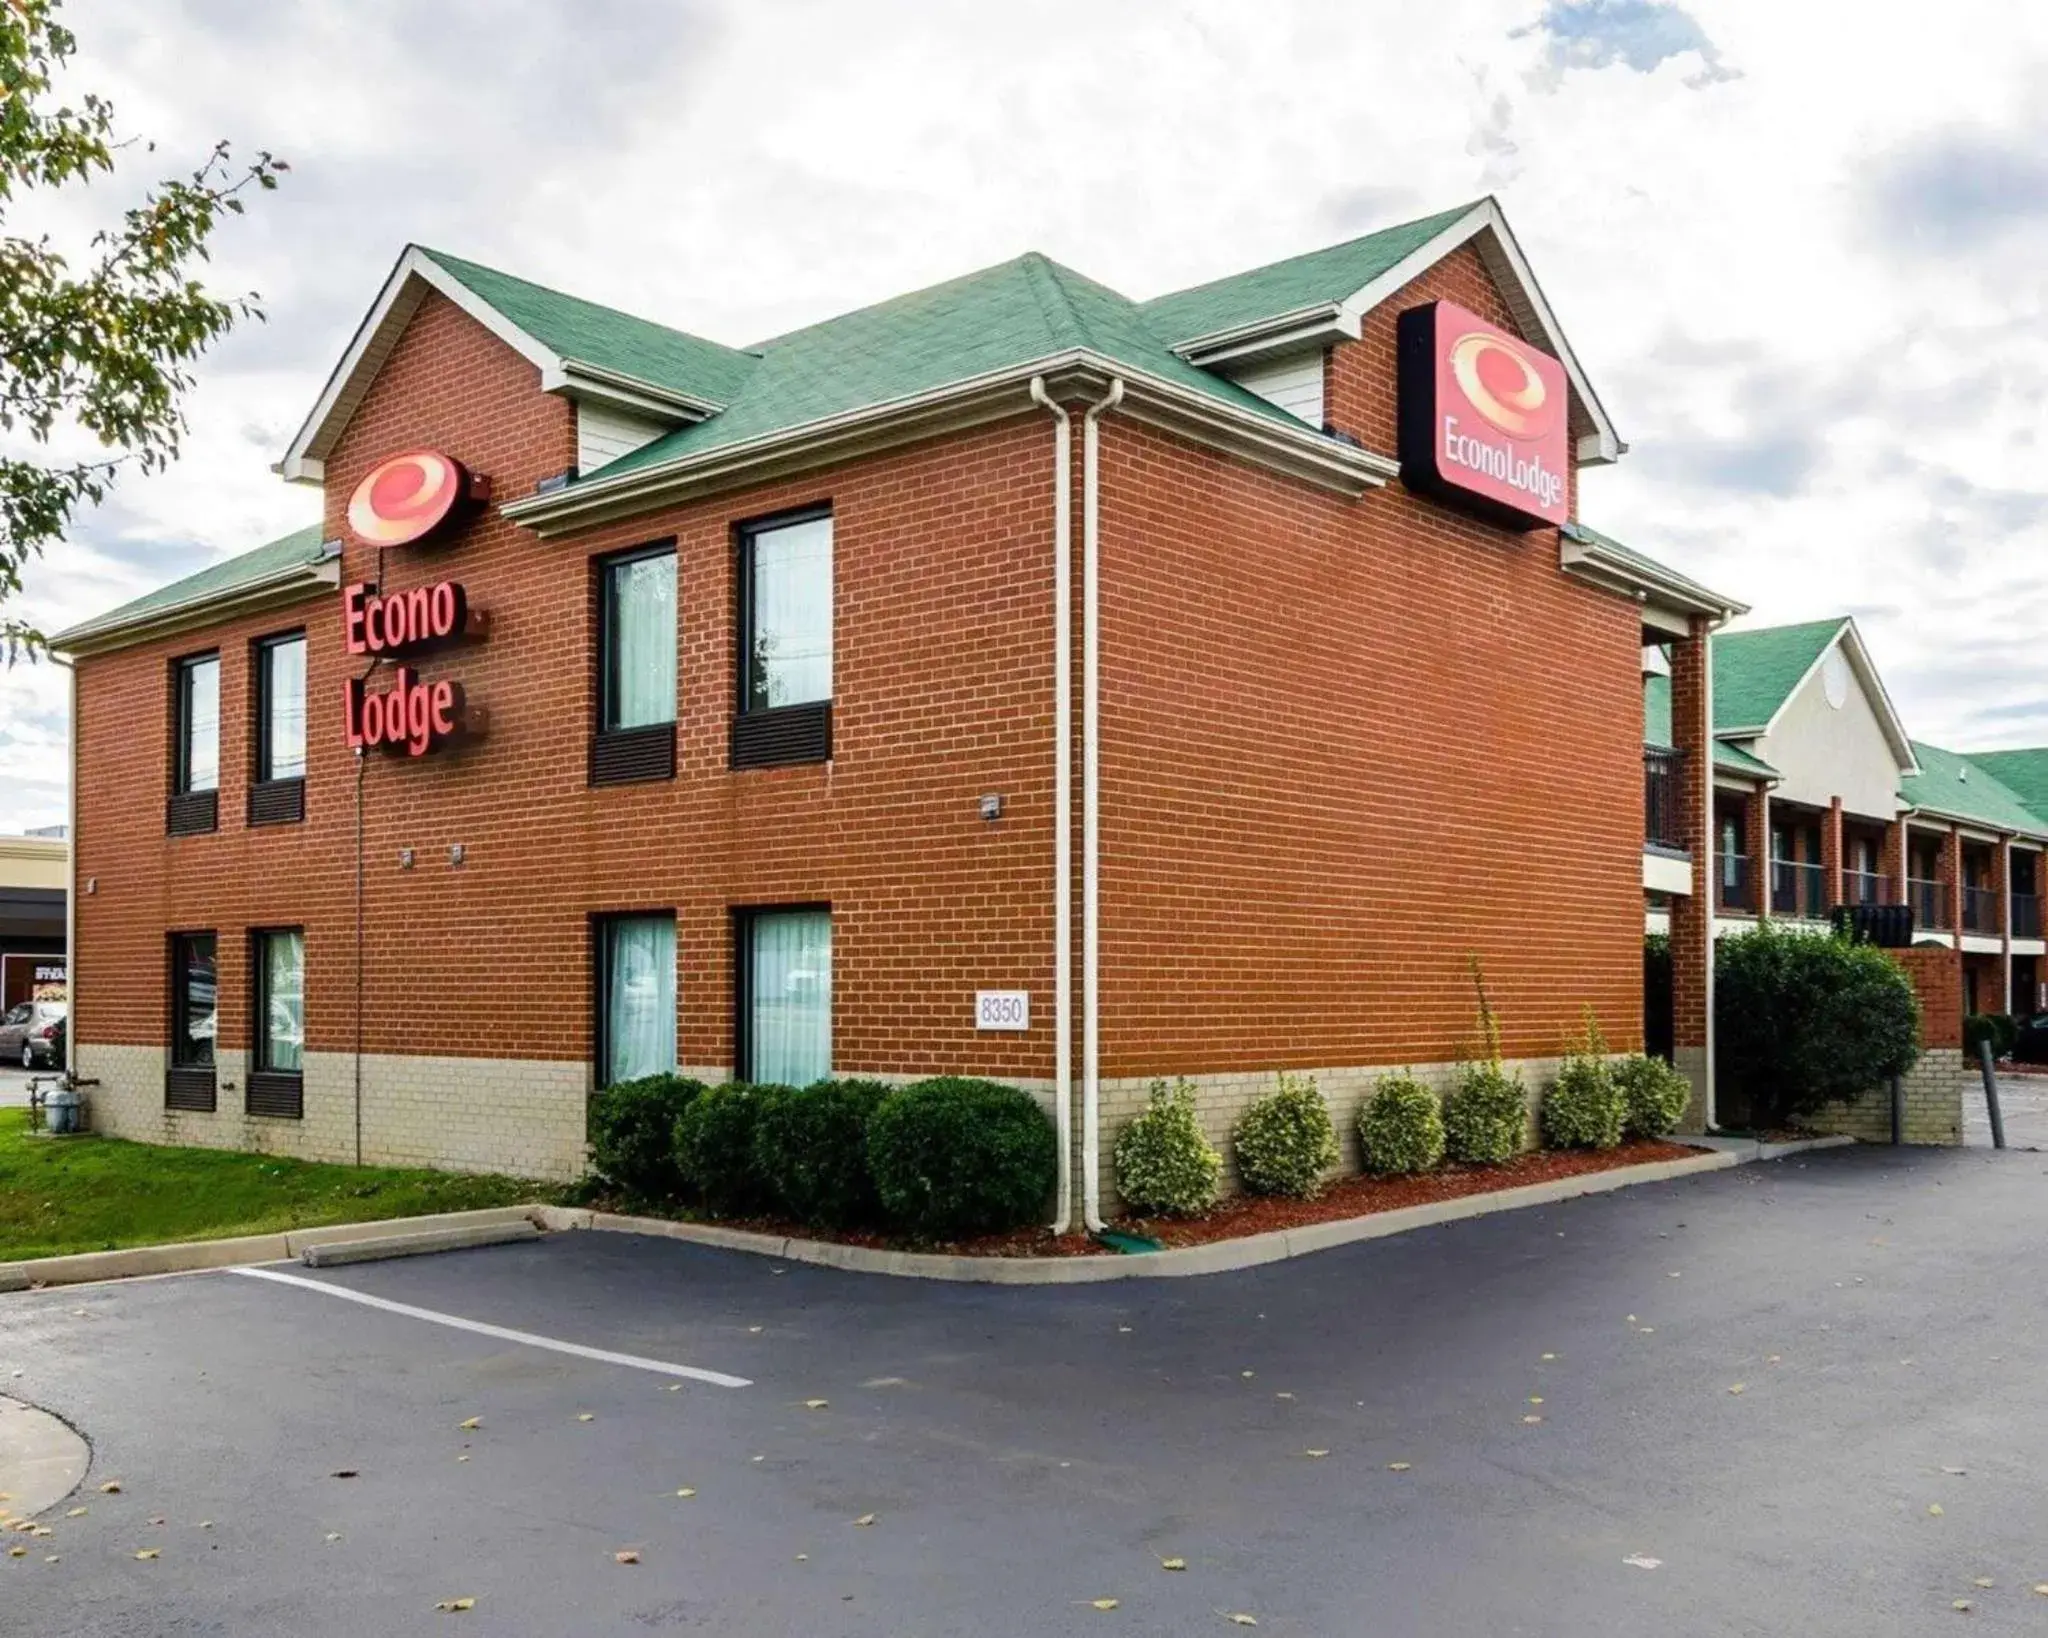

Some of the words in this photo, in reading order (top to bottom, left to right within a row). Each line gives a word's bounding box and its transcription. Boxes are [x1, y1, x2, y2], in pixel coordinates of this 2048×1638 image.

[344, 581, 455, 655] Econo
[343, 667, 454, 757] Lodge
[982, 997, 1022, 1023] 8350
